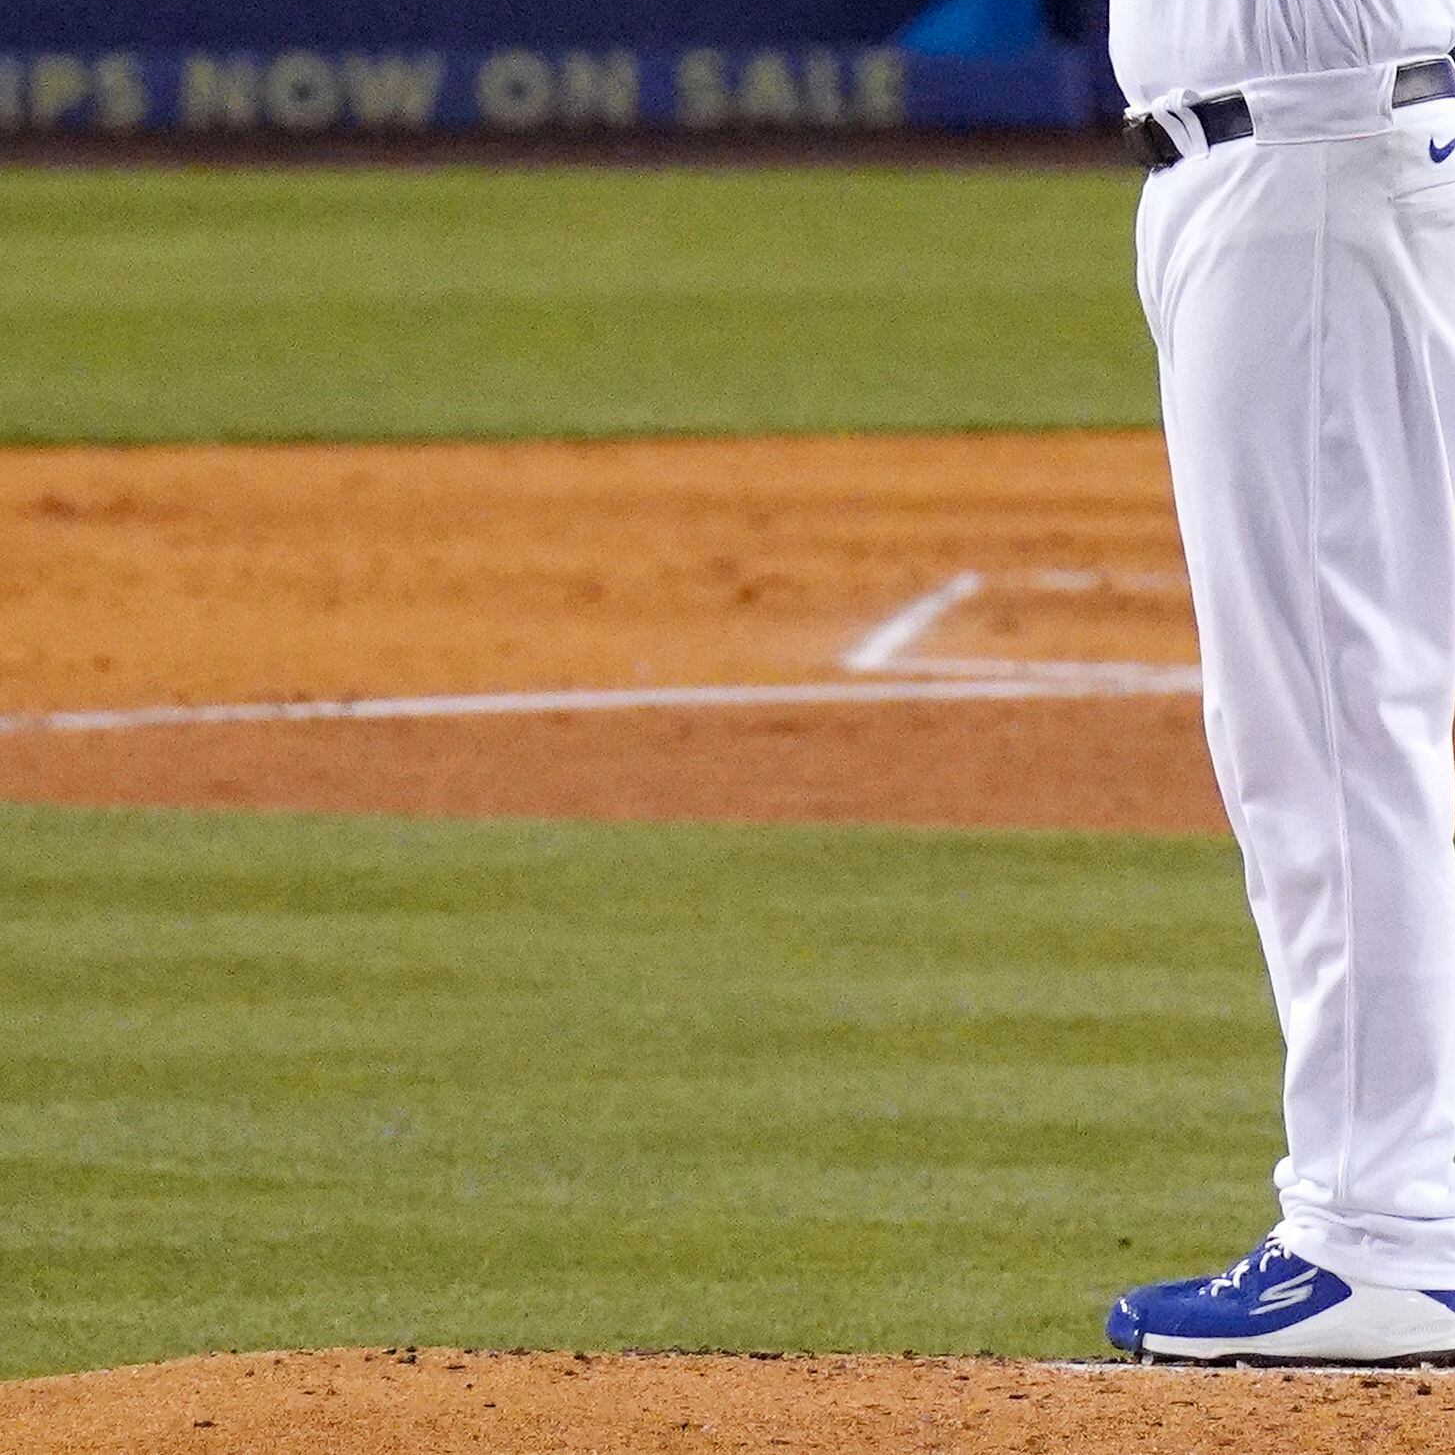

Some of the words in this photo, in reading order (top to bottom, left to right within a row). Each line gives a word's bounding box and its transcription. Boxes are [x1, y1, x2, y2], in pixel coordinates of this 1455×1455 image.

[182, 51, 444, 127] NOW
[476, 51, 640, 129] ON
[676, 49, 904, 129] SALE
